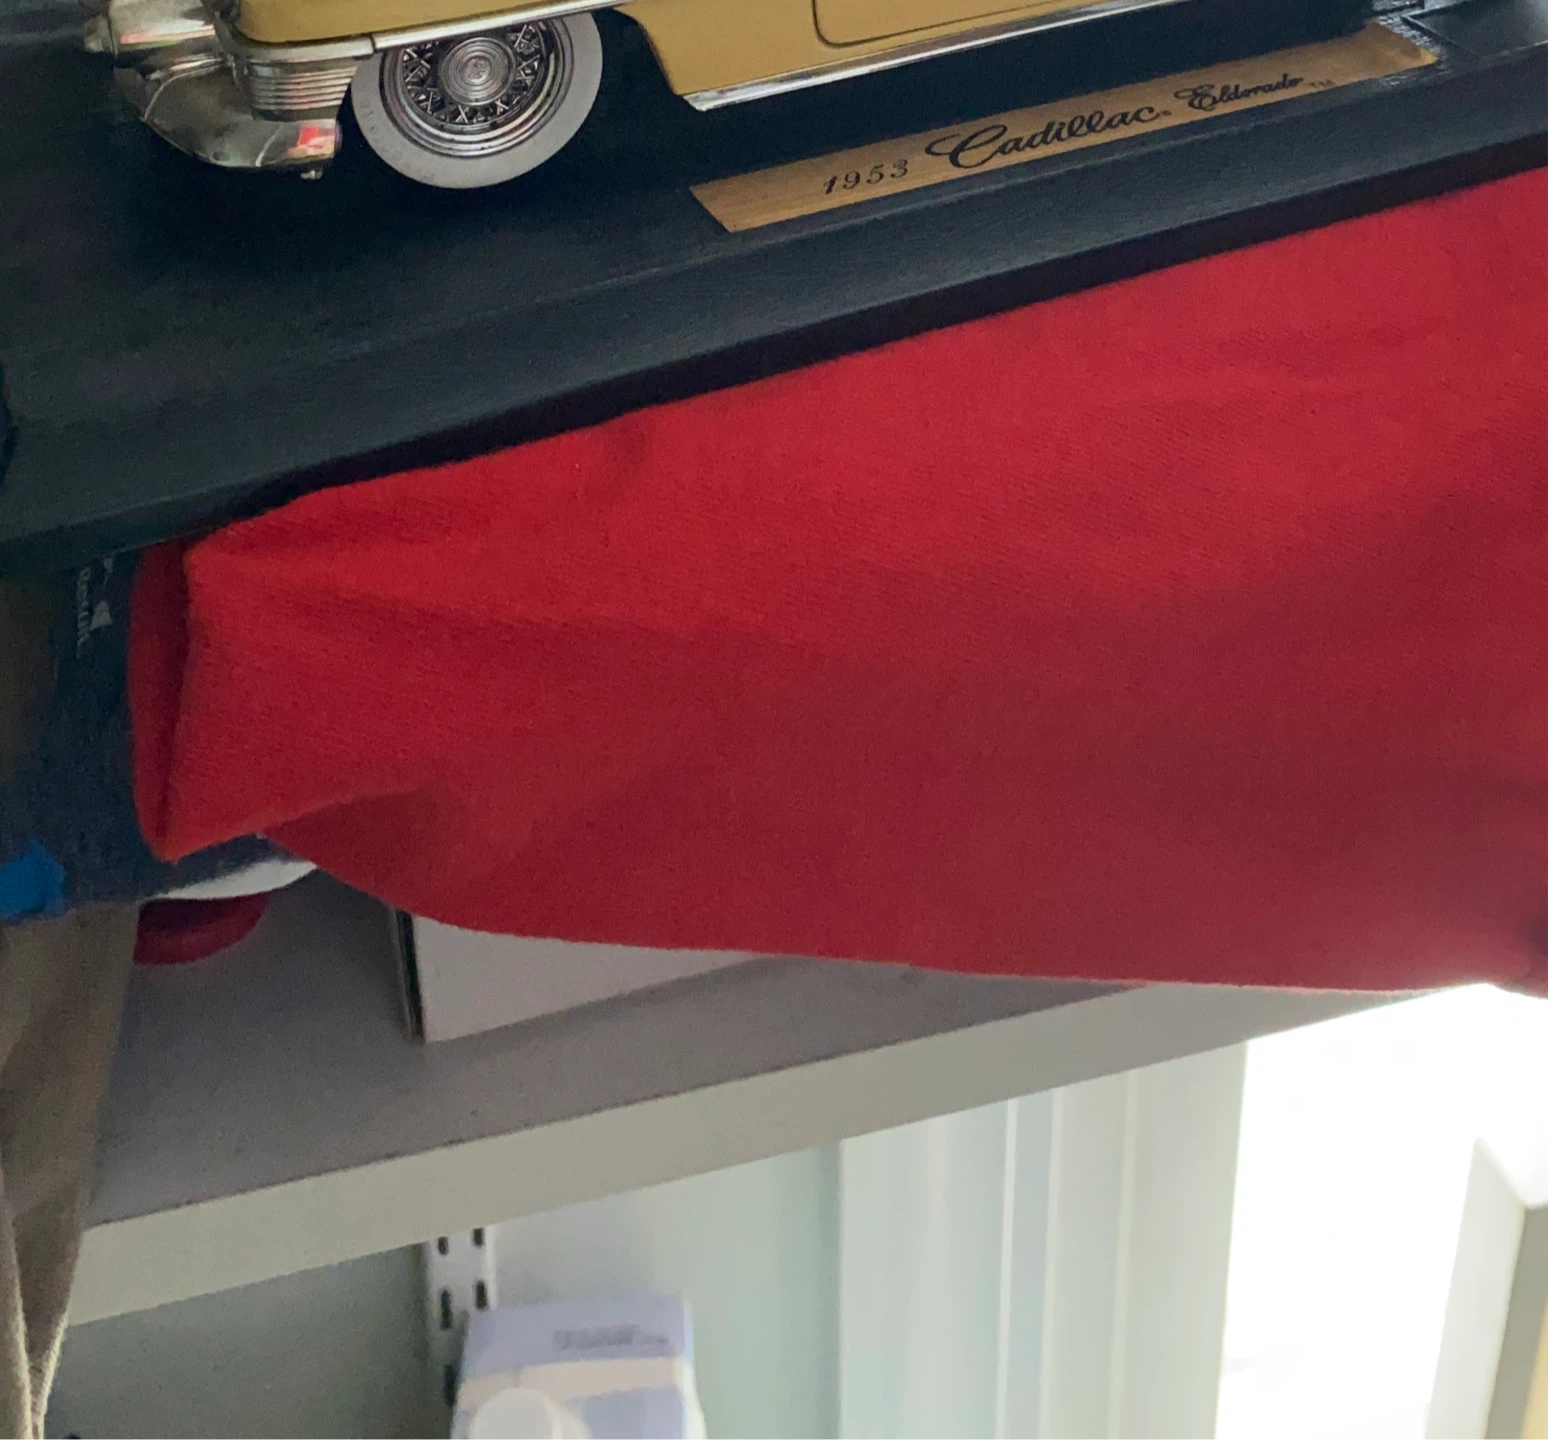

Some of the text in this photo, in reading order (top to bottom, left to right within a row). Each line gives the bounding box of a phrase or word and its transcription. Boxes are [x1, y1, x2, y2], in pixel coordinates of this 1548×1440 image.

[822, 158, 909, 195] 1953
[923, 106, 1161, 170] Cadillac
[1173, 72, 1304, 112] Eldorado
